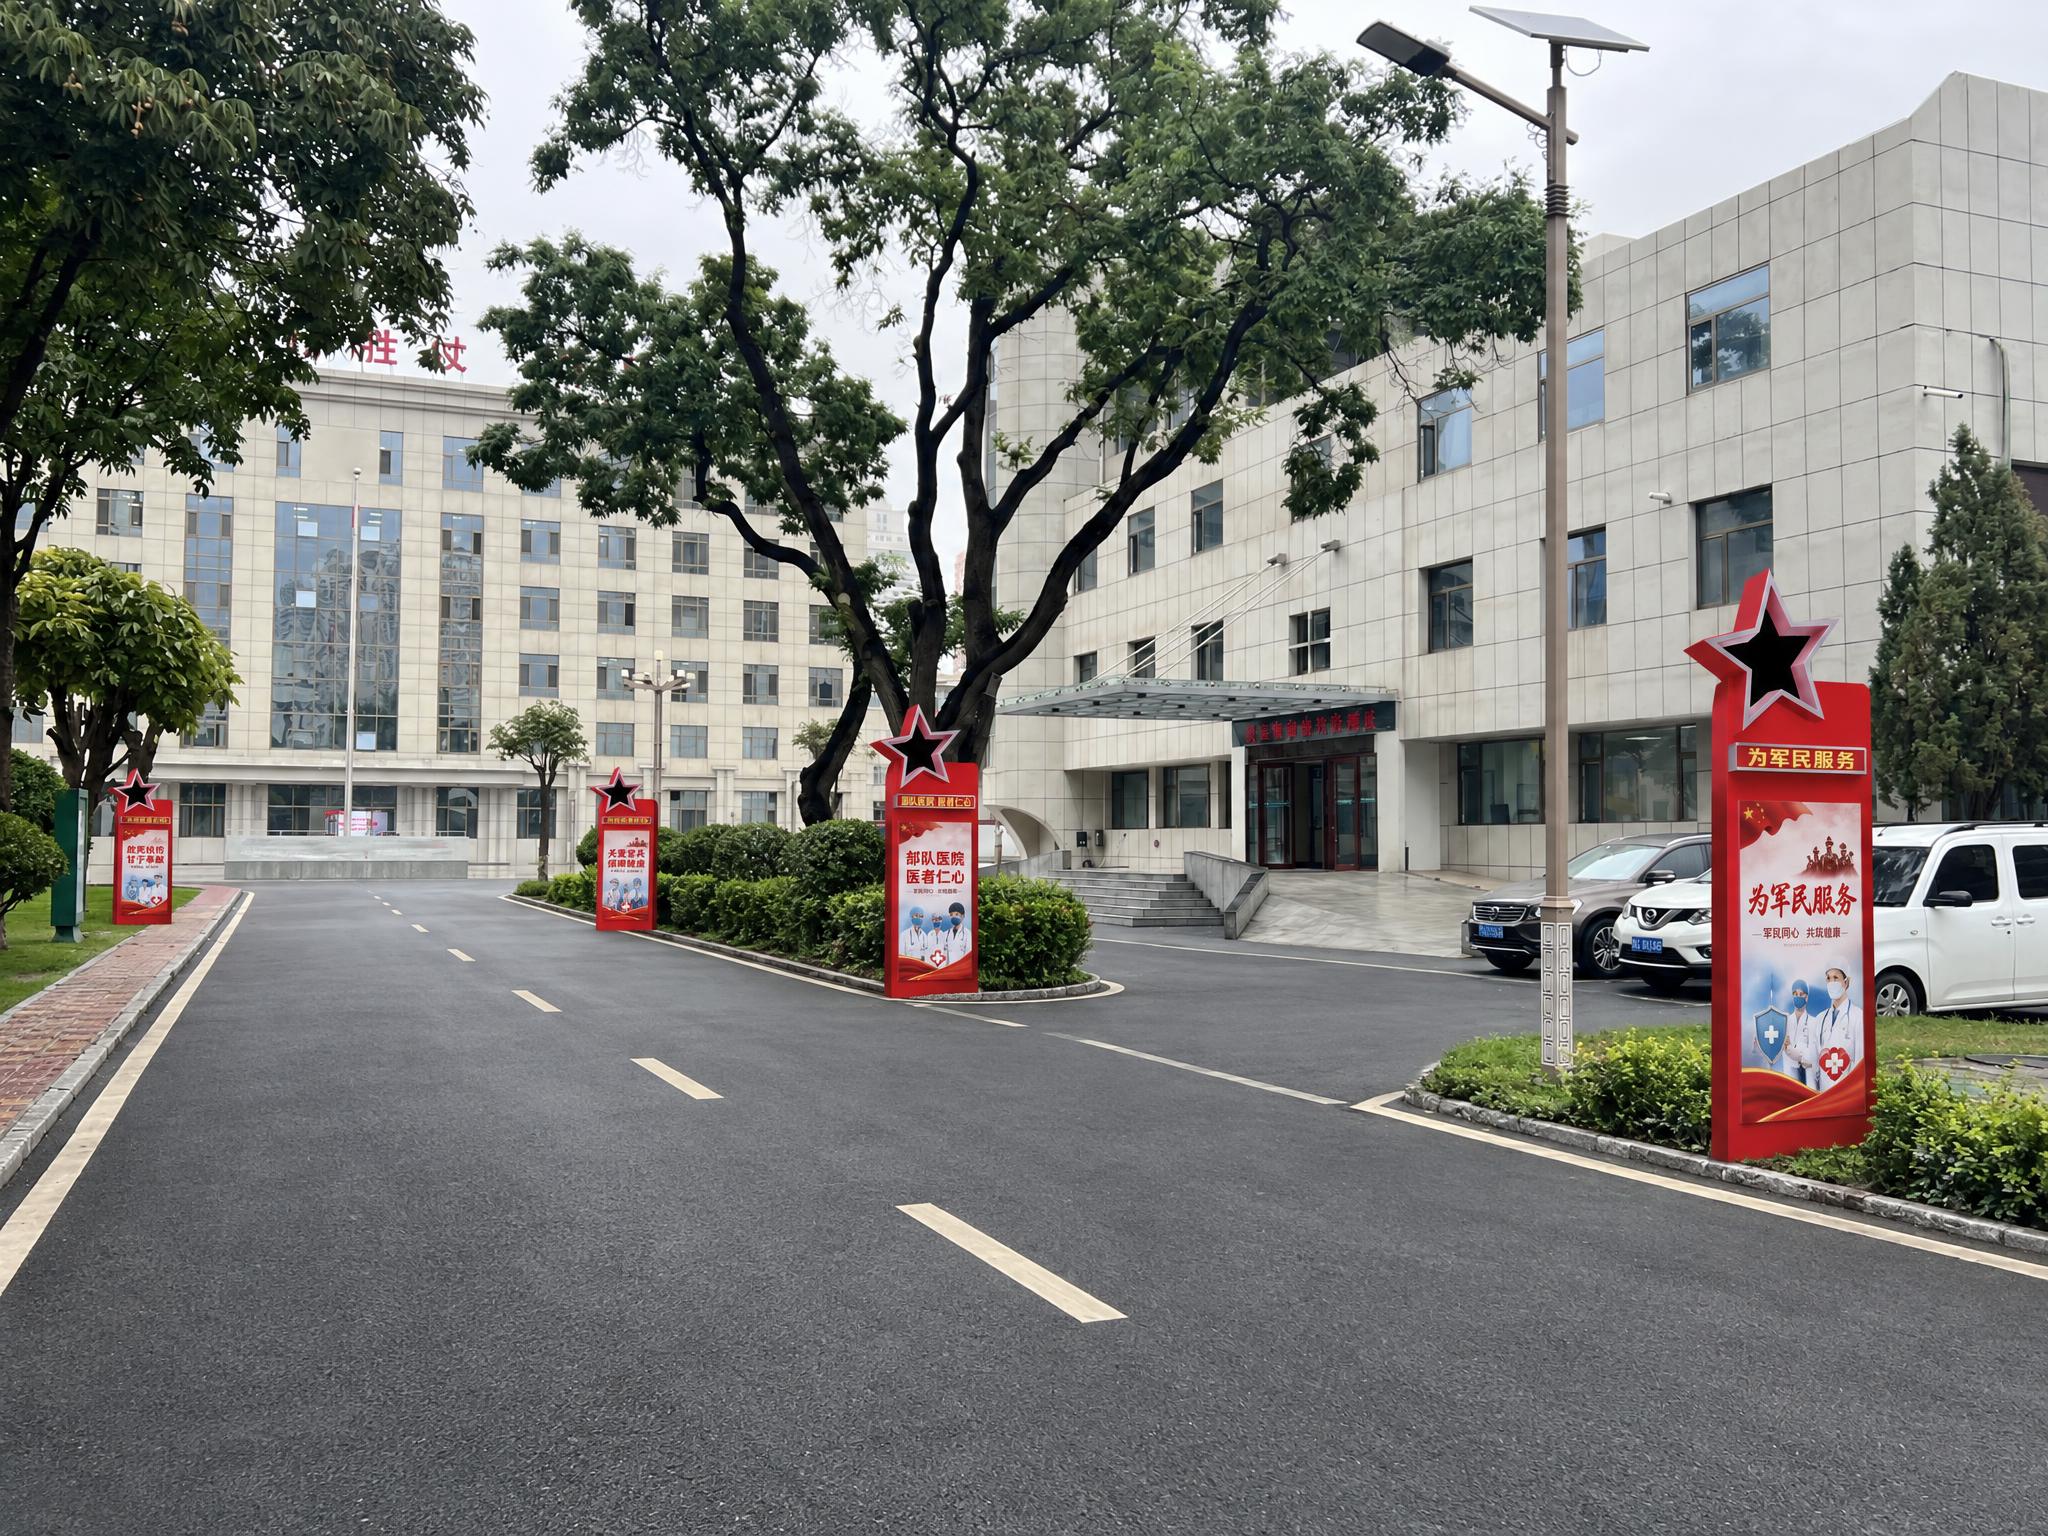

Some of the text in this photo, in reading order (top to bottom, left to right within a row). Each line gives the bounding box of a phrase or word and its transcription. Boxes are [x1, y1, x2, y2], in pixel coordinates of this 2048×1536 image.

[1748, 747, 1855, 770] 为军民服务
[906, 850, 964, 866] 部队医院
[906, 869, 964, 884] 医者仁心
[1748, 882, 1857, 918] 为军民服务
[1762, 927, 1799, 939] 军民同心
